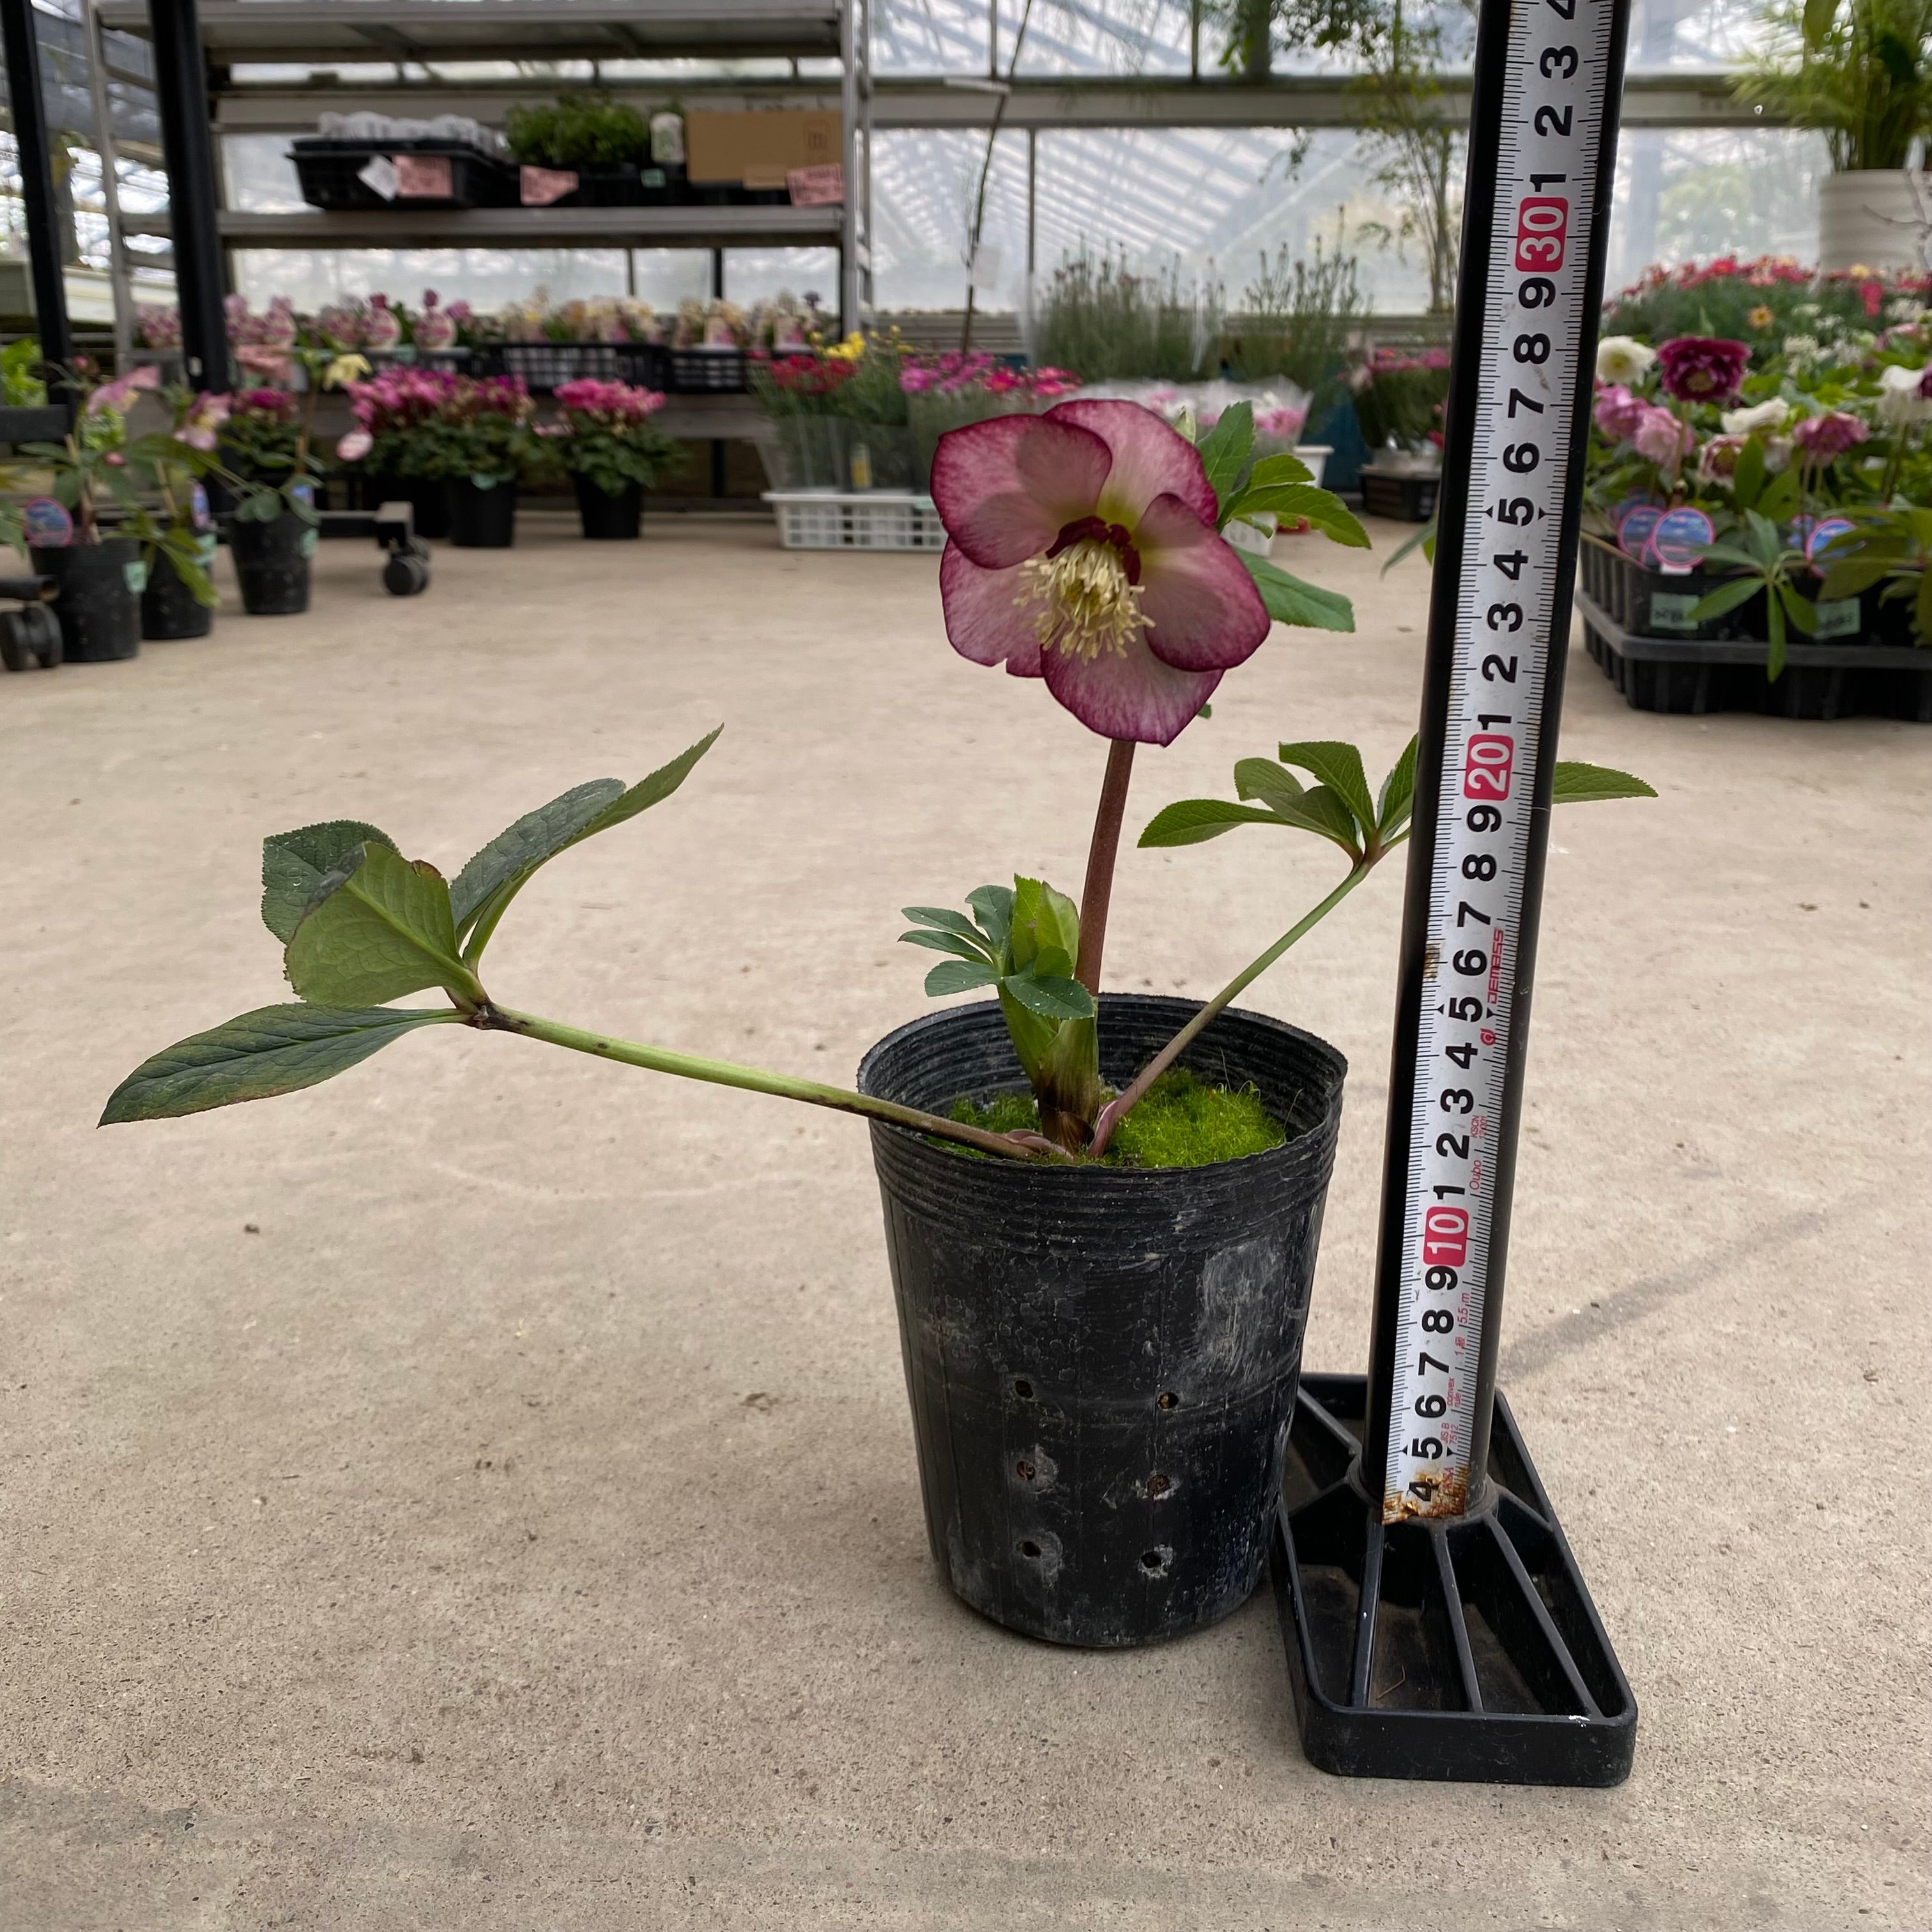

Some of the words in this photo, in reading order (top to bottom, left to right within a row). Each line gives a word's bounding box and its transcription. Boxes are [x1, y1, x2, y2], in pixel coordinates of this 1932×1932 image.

[1539, 45, 1579, 80] 3
[1534, 105, 1574, 137] 2
[1529, 173, 1567, 193] 1
[1519, 204, 1565, 262] 30
[1518, 277, 1556, 309] 9
[1513, 333, 1551, 365] 8
[1507, 388, 1544, 418] 7
[1503, 442, 1540, 473] 6
[1497, 497, 1535, 527] 5
[1493, 549, 1529, 581] 4
[1487, 602, 1524, 632] 3
[1482, 654, 1519, 684] 2
[1477, 714, 1512, 731] 1
[1467, 742, 1511, 792] 20
[1466, 804, 1502, 832] 9
[1462, 854, 1498, 882] 8
[1457, 901, 1491, 928] 7
[1452, 949, 1488, 976] 6
[1448, 996, 1483, 1023] 5
[1445, 1042, 1478, 1070] 4
[1440, 1088, 1474, 1114] 3
[1436, 1133, 1470, 1160] 2
[1433, 1185, 1466, 1200] 1
[1426, 1213, 1466, 1254] 10
[1425, 1265, 1458, 1291] 9
[1460, 1292, 1469, 1304] m
[1422, 1309, 1454, 1334] 8
[1457, 1307, 1468, 1324] 5.5
[1418, 1352, 1450, 1376] 7
[1446, 1377, 1455, 1406] convex
[1452, 1392, 1462, 1408] rule
[1414, 1395, 1447, 1418] 6
[1439, 1431, 1450, 1445] JIS
[1441, 1422, 1450, 1430] B
[1449, 1424, 1459, 1445] 7512
[1411, 1437, 1443, 1460] 5
[1406, 1476, 1441, 1503] 4
